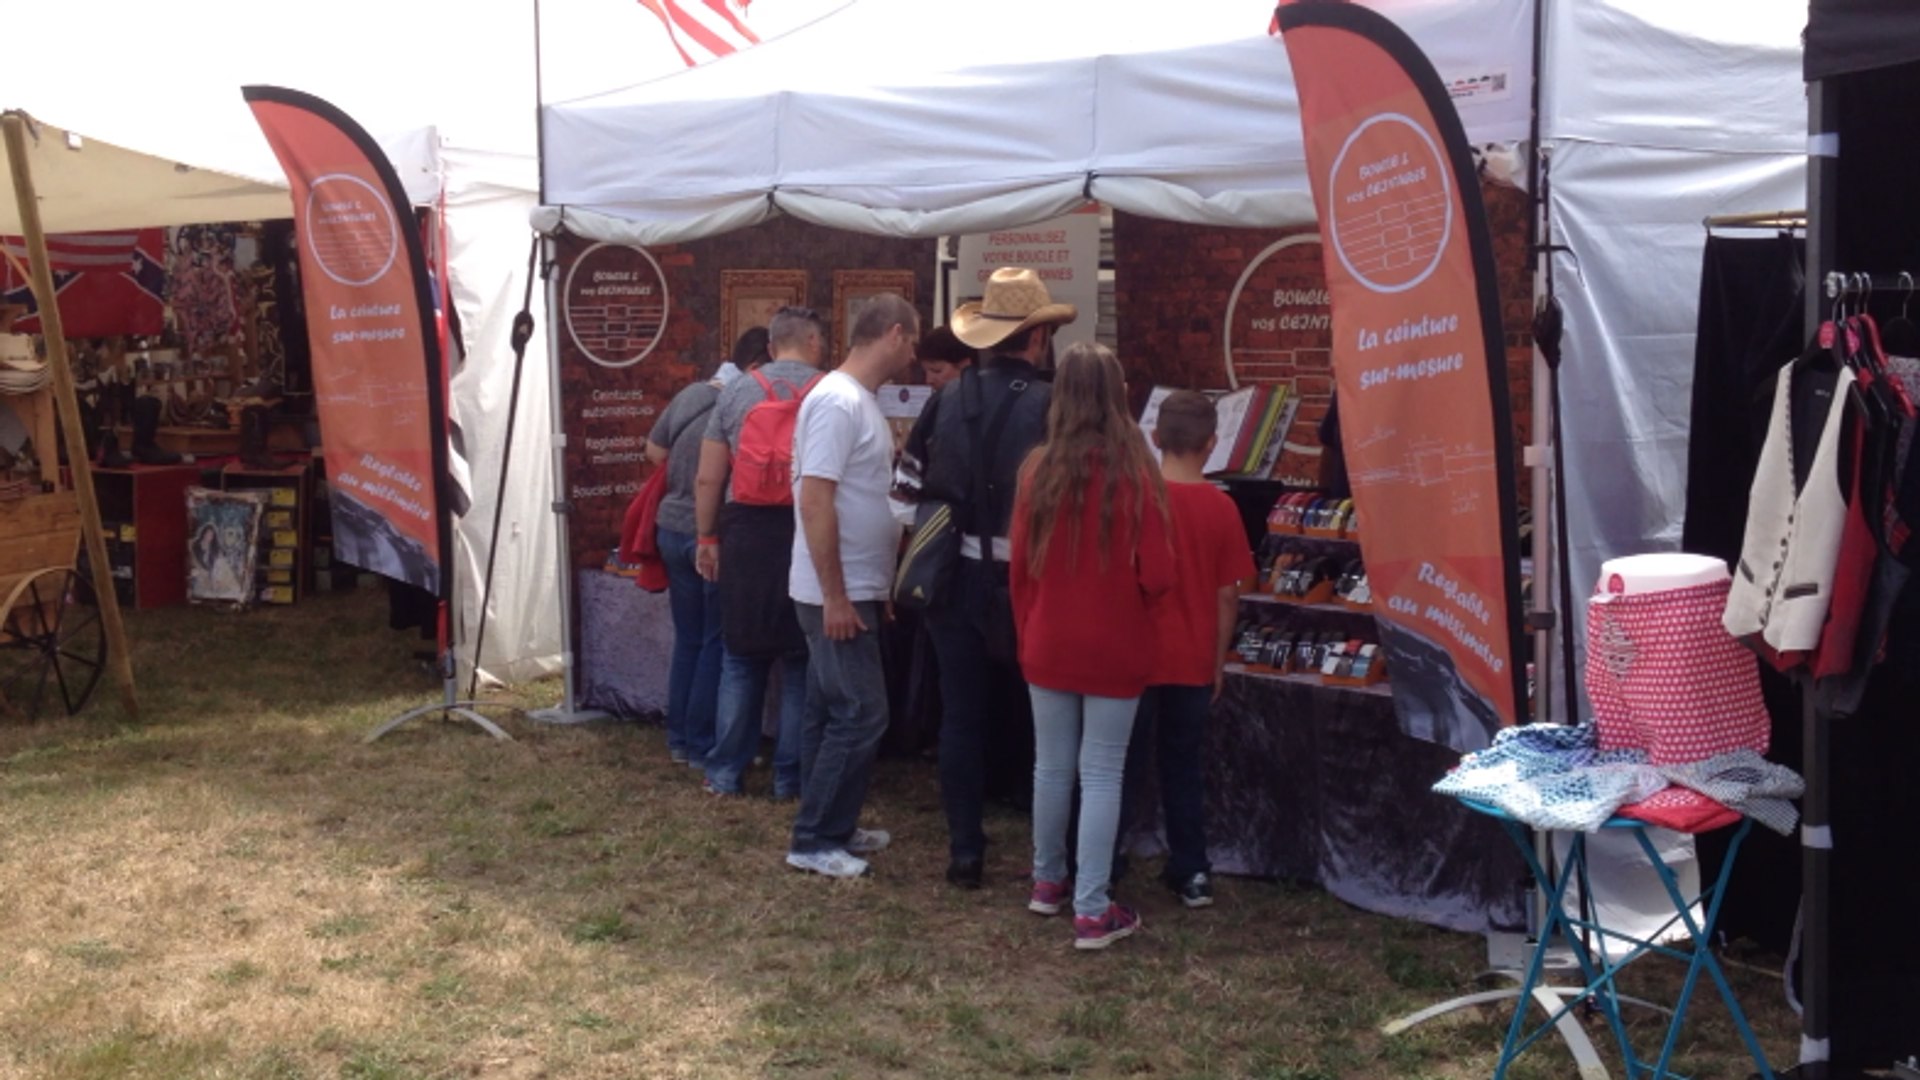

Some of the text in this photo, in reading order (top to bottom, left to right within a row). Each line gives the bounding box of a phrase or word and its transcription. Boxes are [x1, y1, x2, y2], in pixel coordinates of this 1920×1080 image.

[983, 249, 1070, 263] VOTRE BOUCLE ET
[330, 303, 401, 320] La ceinture
[1358, 314, 1459, 352] La ceinture
[1360, 352, 1465, 391] sur-mesure
[1388, 595, 1417, 616] au
